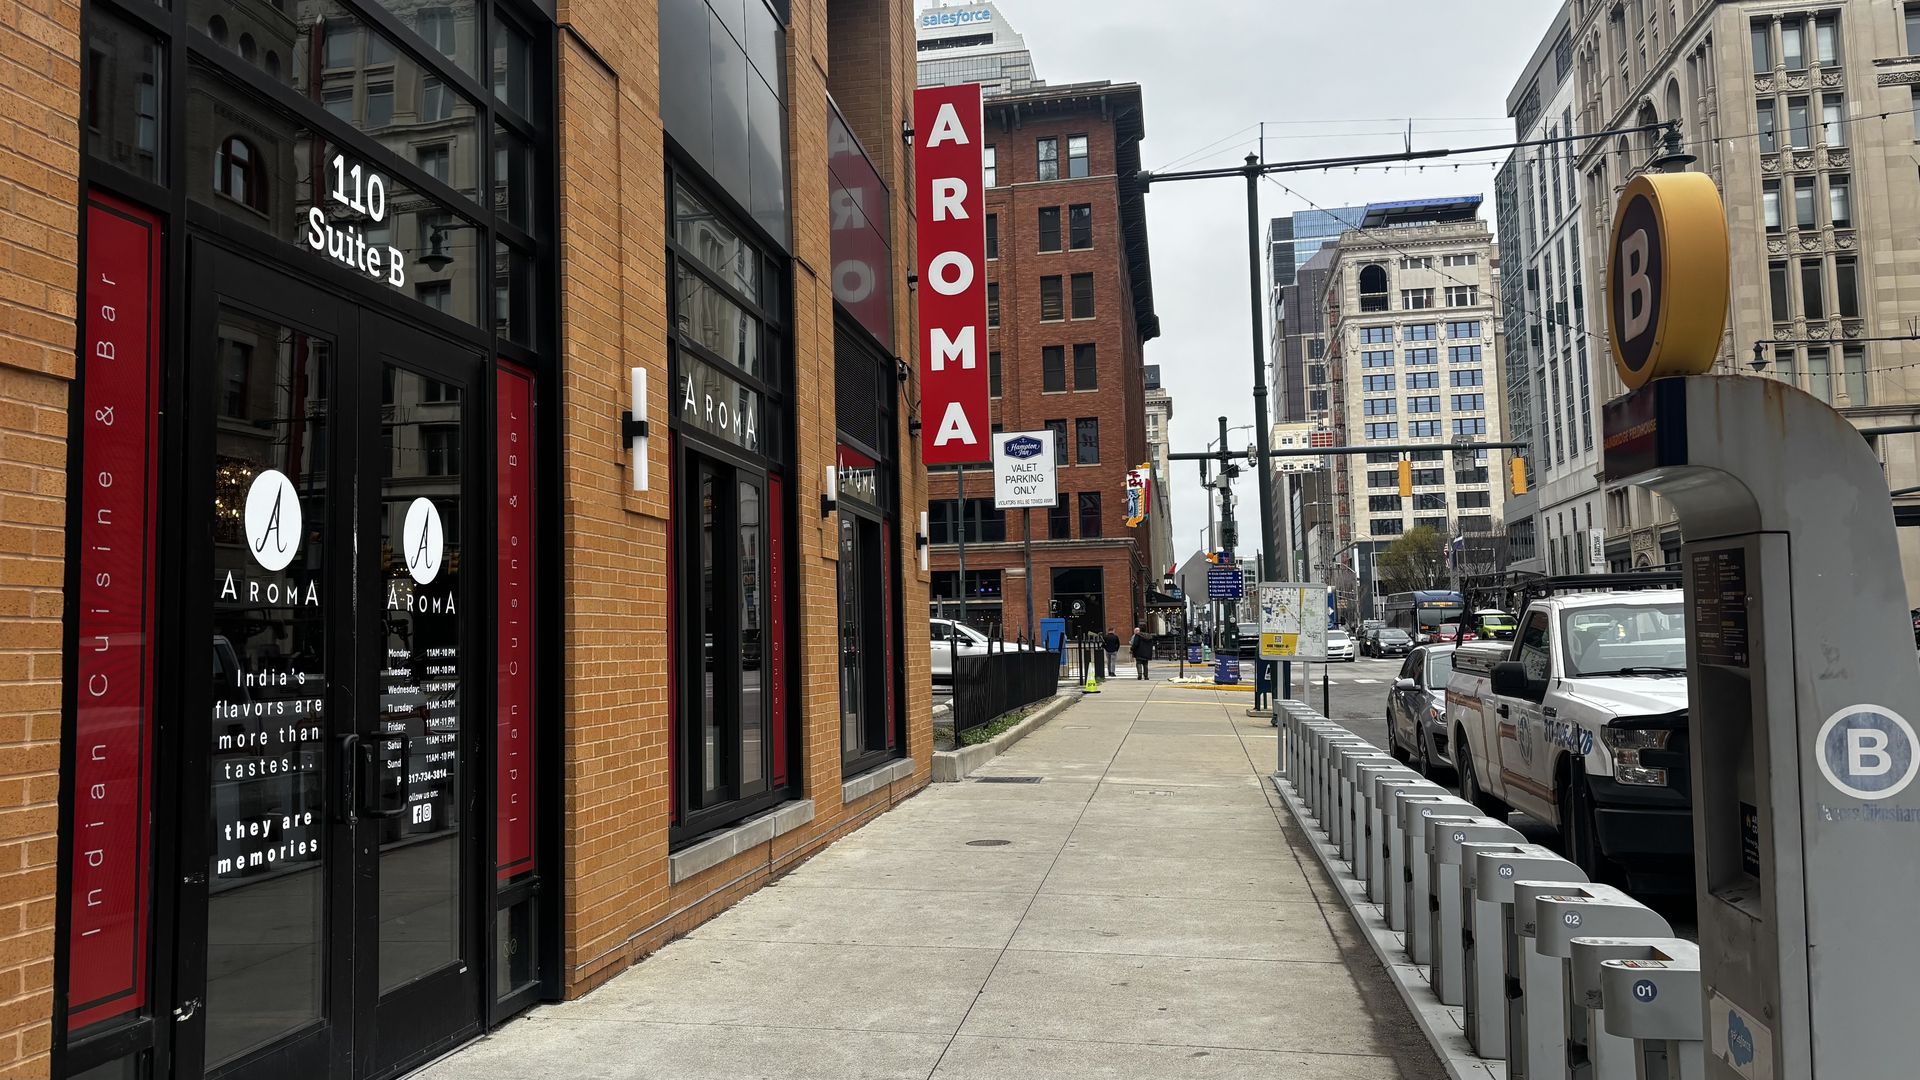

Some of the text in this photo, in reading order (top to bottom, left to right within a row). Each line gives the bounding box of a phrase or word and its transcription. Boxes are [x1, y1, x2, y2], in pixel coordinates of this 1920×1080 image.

[922, 9, 990, 27] salesforce
[332, 154, 385, 222] 110
[308, 206, 405, 288] Suite B
[926, 103, 978, 446] AROMA
[1621, 228, 1652, 342] B
[684, 371, 757, 443] AROMA
[1006, 443, 1041, 452] Hampton
[838, 452, 876, 496] AROMA
[1005, 473, 1044, 484] PARKING
[1011, 463, 1038, 472] VALET
[1013, 485, 1037, 496] ONLY
[255, 481, 288, 553] A
[411, 506, 434, 569] A
[220, 570, 319, 607] AROMA
[387, 584, 456, 615] AROMA
[81, 273, 116, 937] Indian Cuisine & Bar
[509, 412, 518, 822] Indian Cuisine & Bar
[388, 648, 411, 659] Monday:
[237, 668, 306, 688] India's
[388, 667, 412, 677] Tuesday:
[388, 685, 420, 695] Wednesday:
[215, 699, 322, 718] flavors are
[219, 725, 319, 749] more than
[388, 722, 406, 731] Friday:
[1847, 728, 1892, 776] B
[224, 758, 313, 780] tastes...
[408, 793, 423, 802] ollow
[423, 791, 430, 799] us
[224, 811, 312, 841] they are
[1453, 833, 1465, 841] 04
[217, 838, 318, 875] memories
[1499, 867, 1513, 876] 03
[1564, 914, 1580, 925] 02
[1636, 985, 1653, 997] 01
